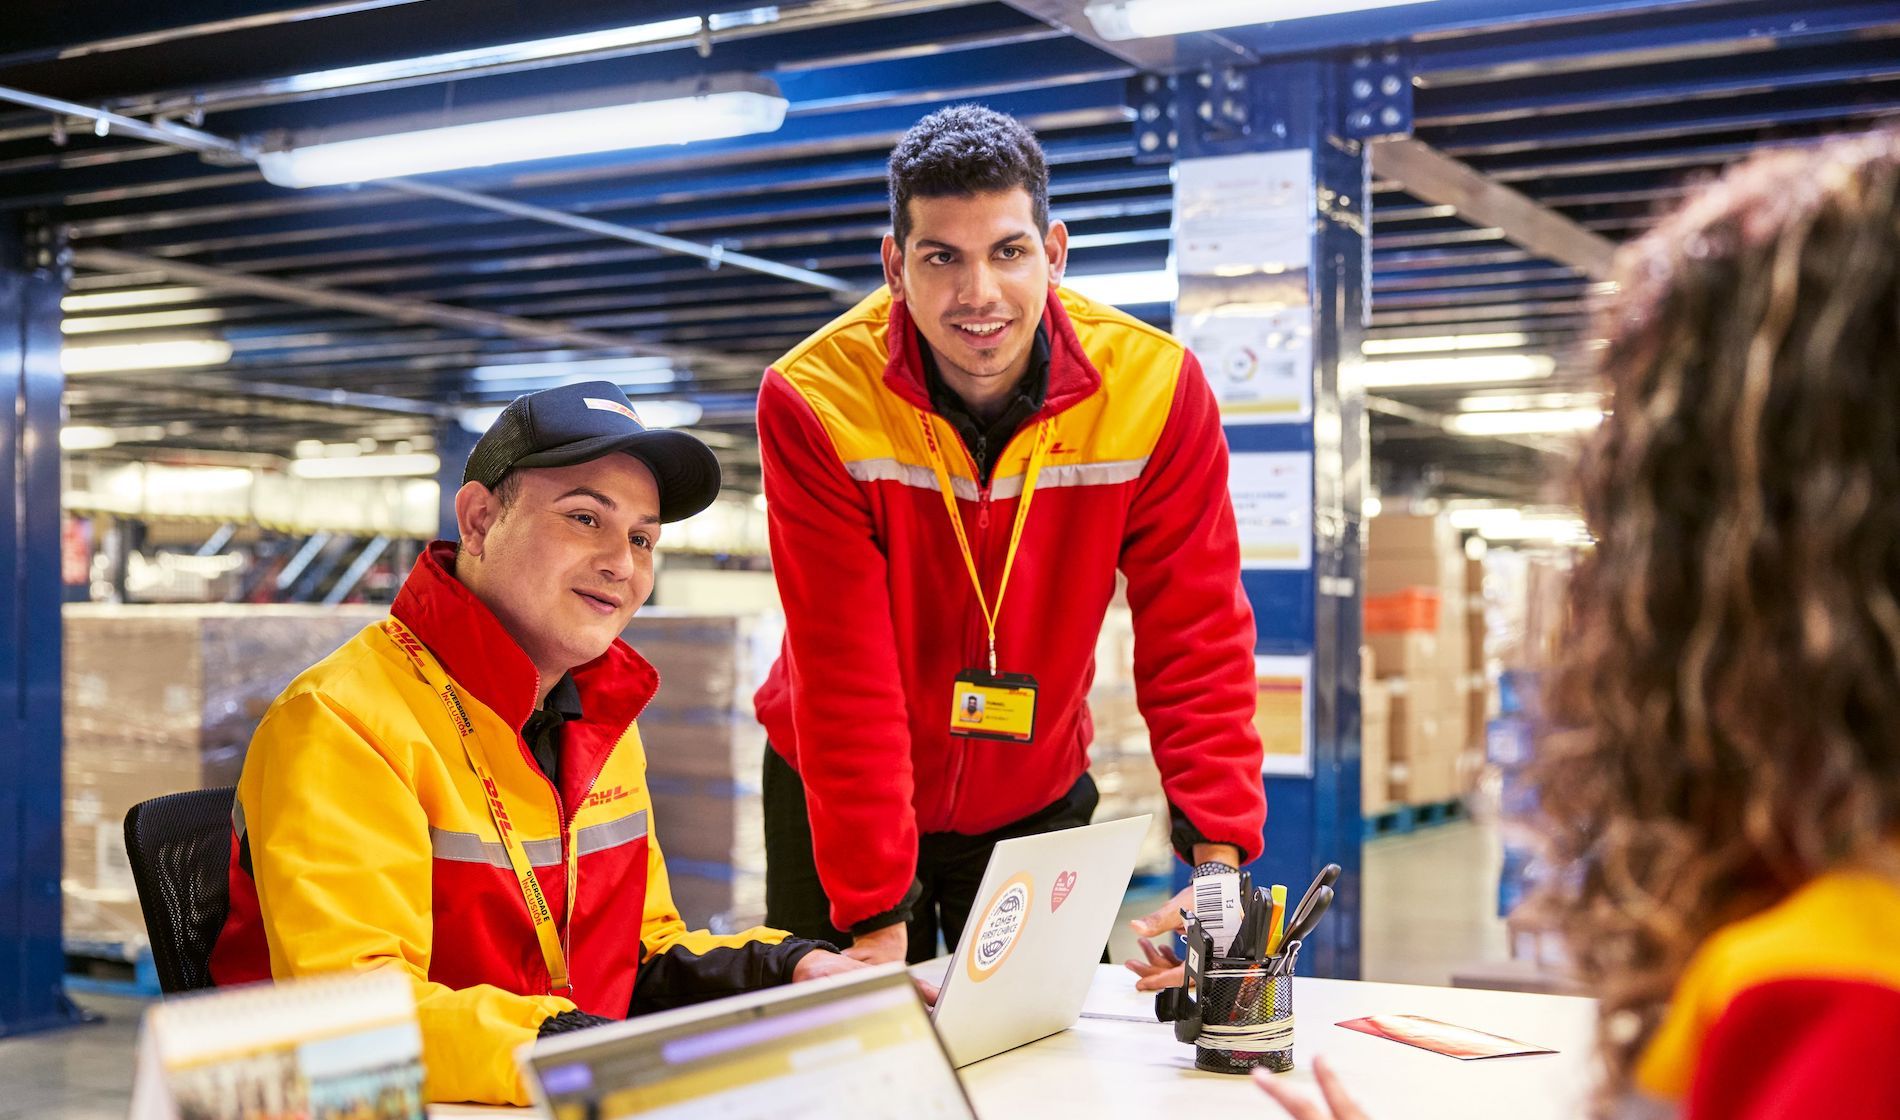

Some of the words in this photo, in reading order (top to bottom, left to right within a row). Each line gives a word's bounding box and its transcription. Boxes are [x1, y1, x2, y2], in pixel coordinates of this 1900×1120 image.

[386, 621, 424, 658] DHL
[441, 691, 468, 737] INCLUSIÓN
[445, 684, 471, 728] DIVERSIDAD
[482, 776, 513, 837] DHL
[588, 785, 629, 807] DHL
[521, 878, 543, 926] INCLUSIÓN
[526, 870, 548, 917] DIVERSIDAD
[1225, 898, 1235, 909] F1
